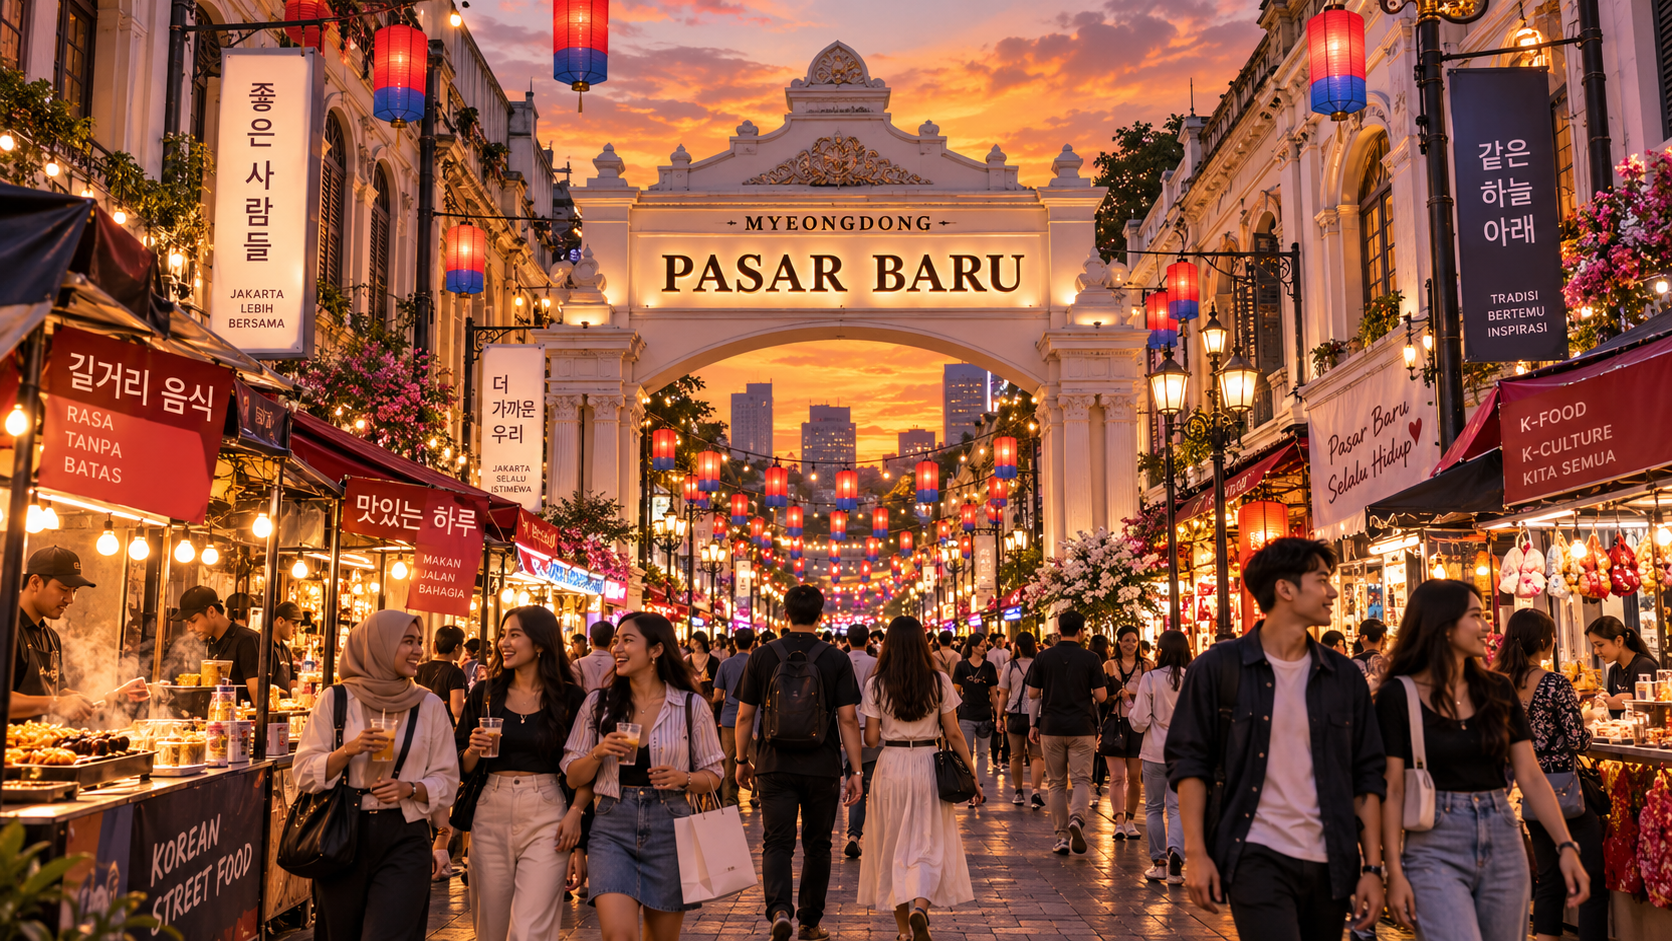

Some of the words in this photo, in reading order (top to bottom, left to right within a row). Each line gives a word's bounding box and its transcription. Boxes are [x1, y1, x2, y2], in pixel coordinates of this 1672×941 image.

[246, 82, 277, 148] 좋은
[1478, 139, 1531, 171] 같은
[1480, 178, 1533, 208] 하늘
[243, 160, 275, 262] 사람들
[744, 215, 932, 231] MYEONGDONG
[1483, 213, 1536, 247] 아래
[661, 253, 848, 293] PASAR
[872, 253, 1025, 293] BARU
[229, 287, 285, 300] JAKARTA
[1490, 290, 1539, 305] TRADISI
[240, 303, 274, 315] LEBIH
[1487, 305, 1545, 322] BERTEMU
[228, 318, 285, 329] BERSAMA
[1487, 322, 1548, 338] INSPIRASI
[68, 352, 149, 406] 길거리
[161, 376, 214, 422] 음식
[492, 374, 509, 395] 더
[66, 405, 115, 431] RASA
[491, 399, 536, 419] 가까운
[1519, 401, 1588, 433] K-FOOD
[65, 430, 123, 459] TANPA
[491, 424, 524, 444] 우리
[1328, 433, 1368, 466] Pasar
[1371, 400, 1410, 438] Baru
[1521, 424, 1614, 463] K-CULTURE
[64, 456, 122, 484] BATAS
[492, 464, 531, 473] JAKARTA
[496, 475, 527, 483] SELALU
[1327, 463, 1369, 504] Selalu
[1371, 438, 1412, 478] Hidup
[1522, 464, 1558, 486] KITA
[1561, 449, 1617, 476] SEMUA
[491, 485, 532, 494] ISTIMEWA
[356, 494, 424, 531] 맛있는
[433, 505, 477, 538] 하루
[423, 554, 462, 569] MAKAN
[420, 569, 456, 583] JALAN
[418, 583, 465, 599] BAHAGIA
[150, 813, 221, 888] KOREAN
[150, 864, 213, 937] STREET
[216, 842, 253, 897] FOOD
